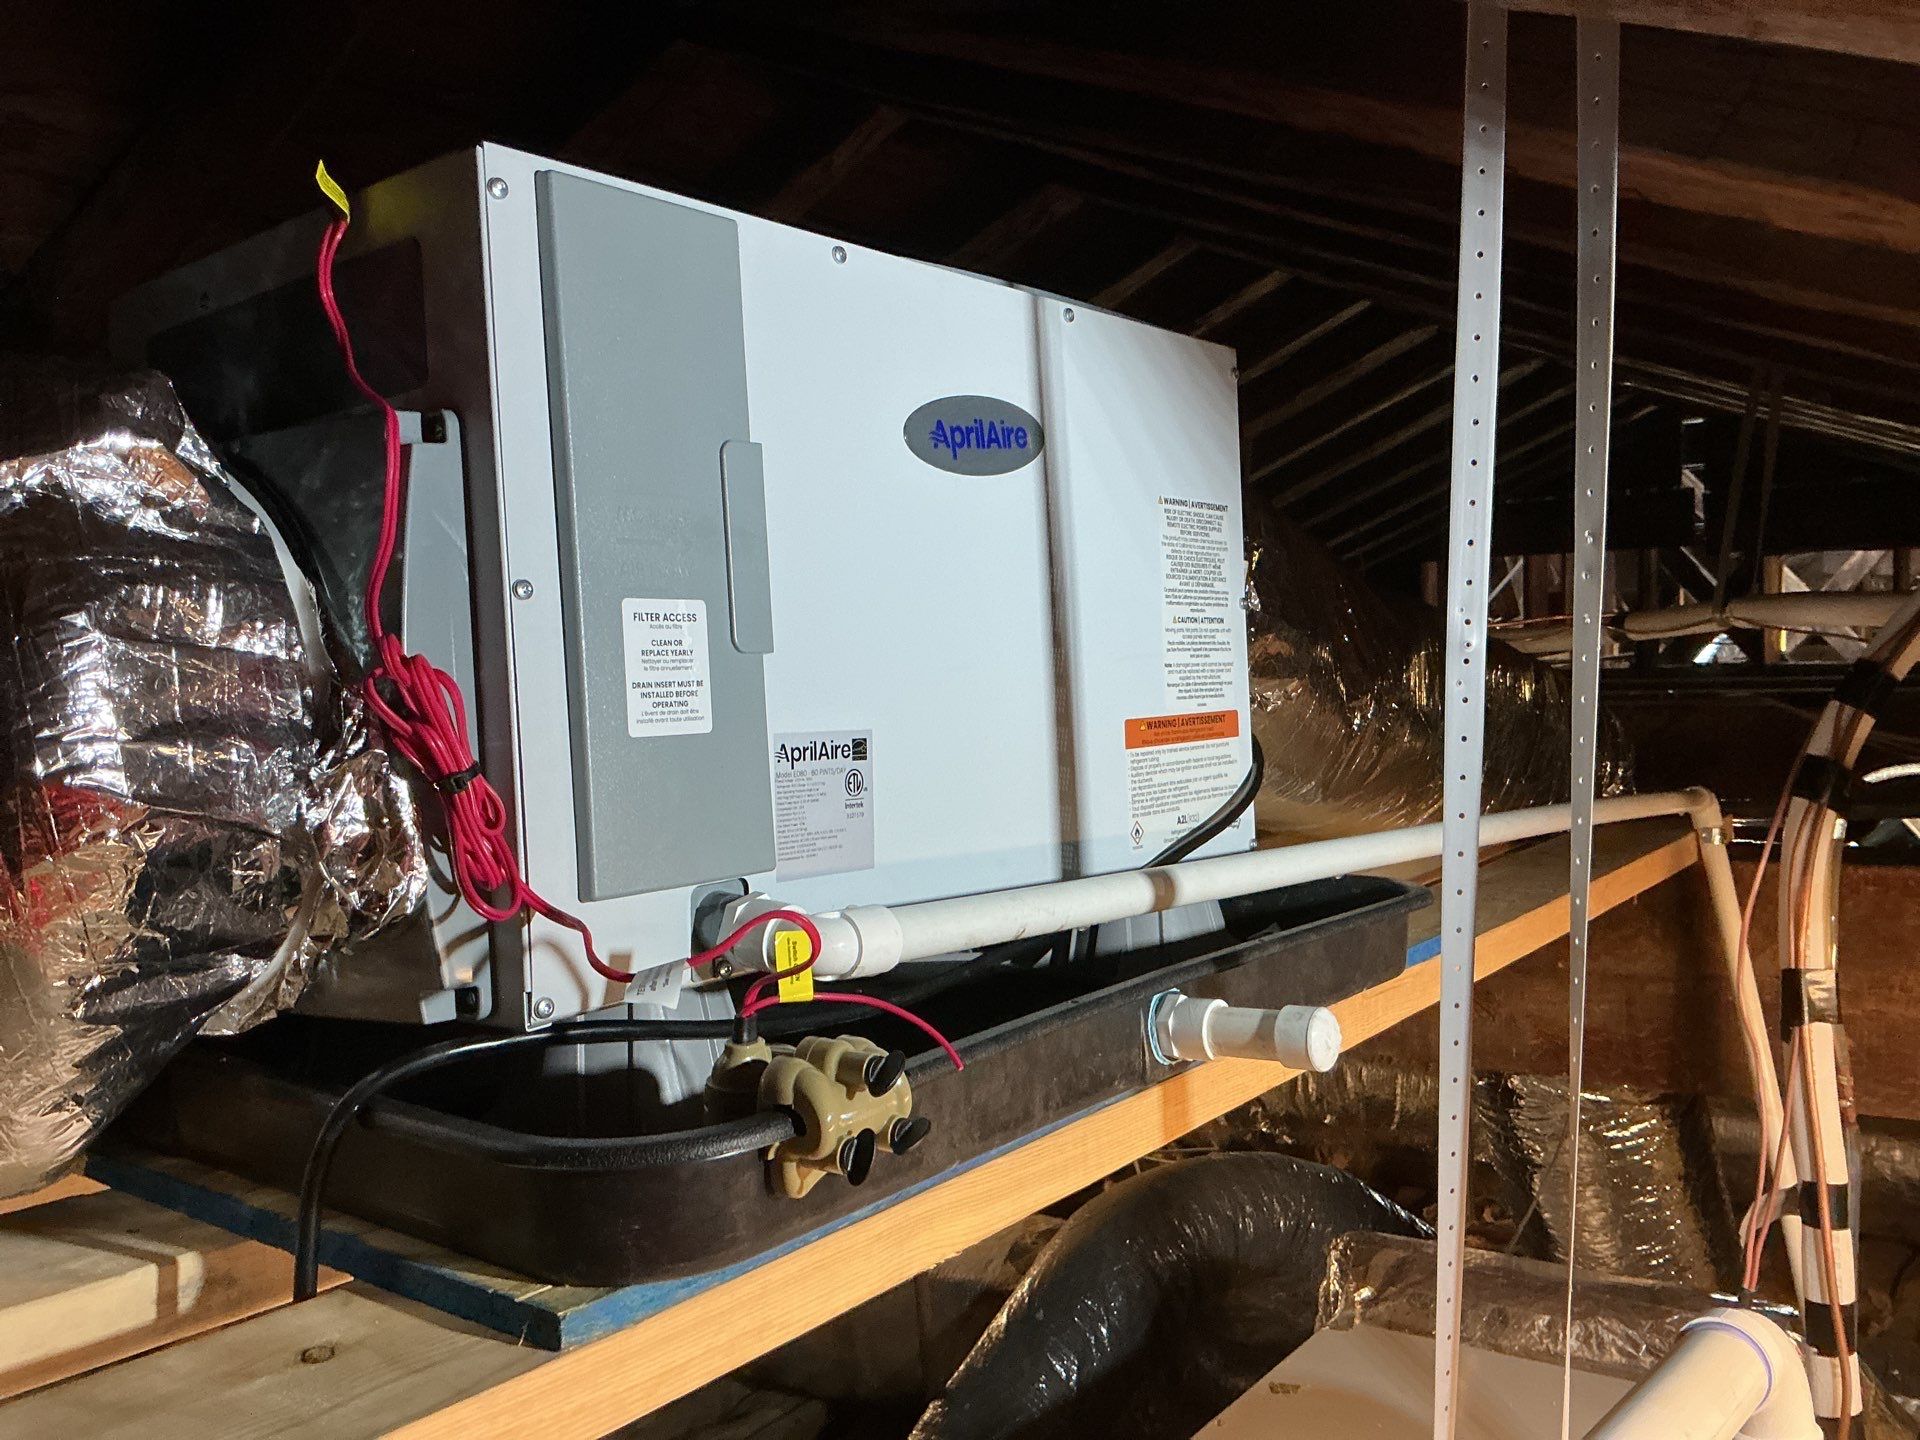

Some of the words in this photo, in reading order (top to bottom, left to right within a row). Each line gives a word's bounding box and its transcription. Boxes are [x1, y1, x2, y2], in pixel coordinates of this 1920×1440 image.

[928, 419, 1028, 460] AprilAire
[1163, 498, 1188, 507] WARNING
[1191, 501, 1228, 512] AVERTISSEMENT
[633, 612, 660, 622] FILTER
[662, 613, 697, 622] ACCESS
[1178, 616, 1198, 624] CAUTION
[1201, 616, 1225, 624] ATTENTION
[651, 639, 672, 647] CLEAN
[673, 639, 683, 647] OR
[641, 649, 669, 657] REPLACE
[670, 649, 694, 657] YEARLY
[632, 681, 652, 689] DRAIN
[654, 681, 676, 689] INSERT
[677, 680, 695, 688] MUST
[640, 690, 674, 699] INSTALLED
[675, 689, 698, 698] BEFORE
[652, 700, 689, 708] OPERATING
[1146, 719, 1176, 730] WARNING
[1181, 714, 1226, 726] AVERTISSEMENT
[775, 740, 851, 770] AprilAire
[776, 770, 792, 778] Model
[811, 768, 818, 776] 80
[819, 767, 846, 775] PINTS/DAY
[844, 801, 864, 809] Intertek
